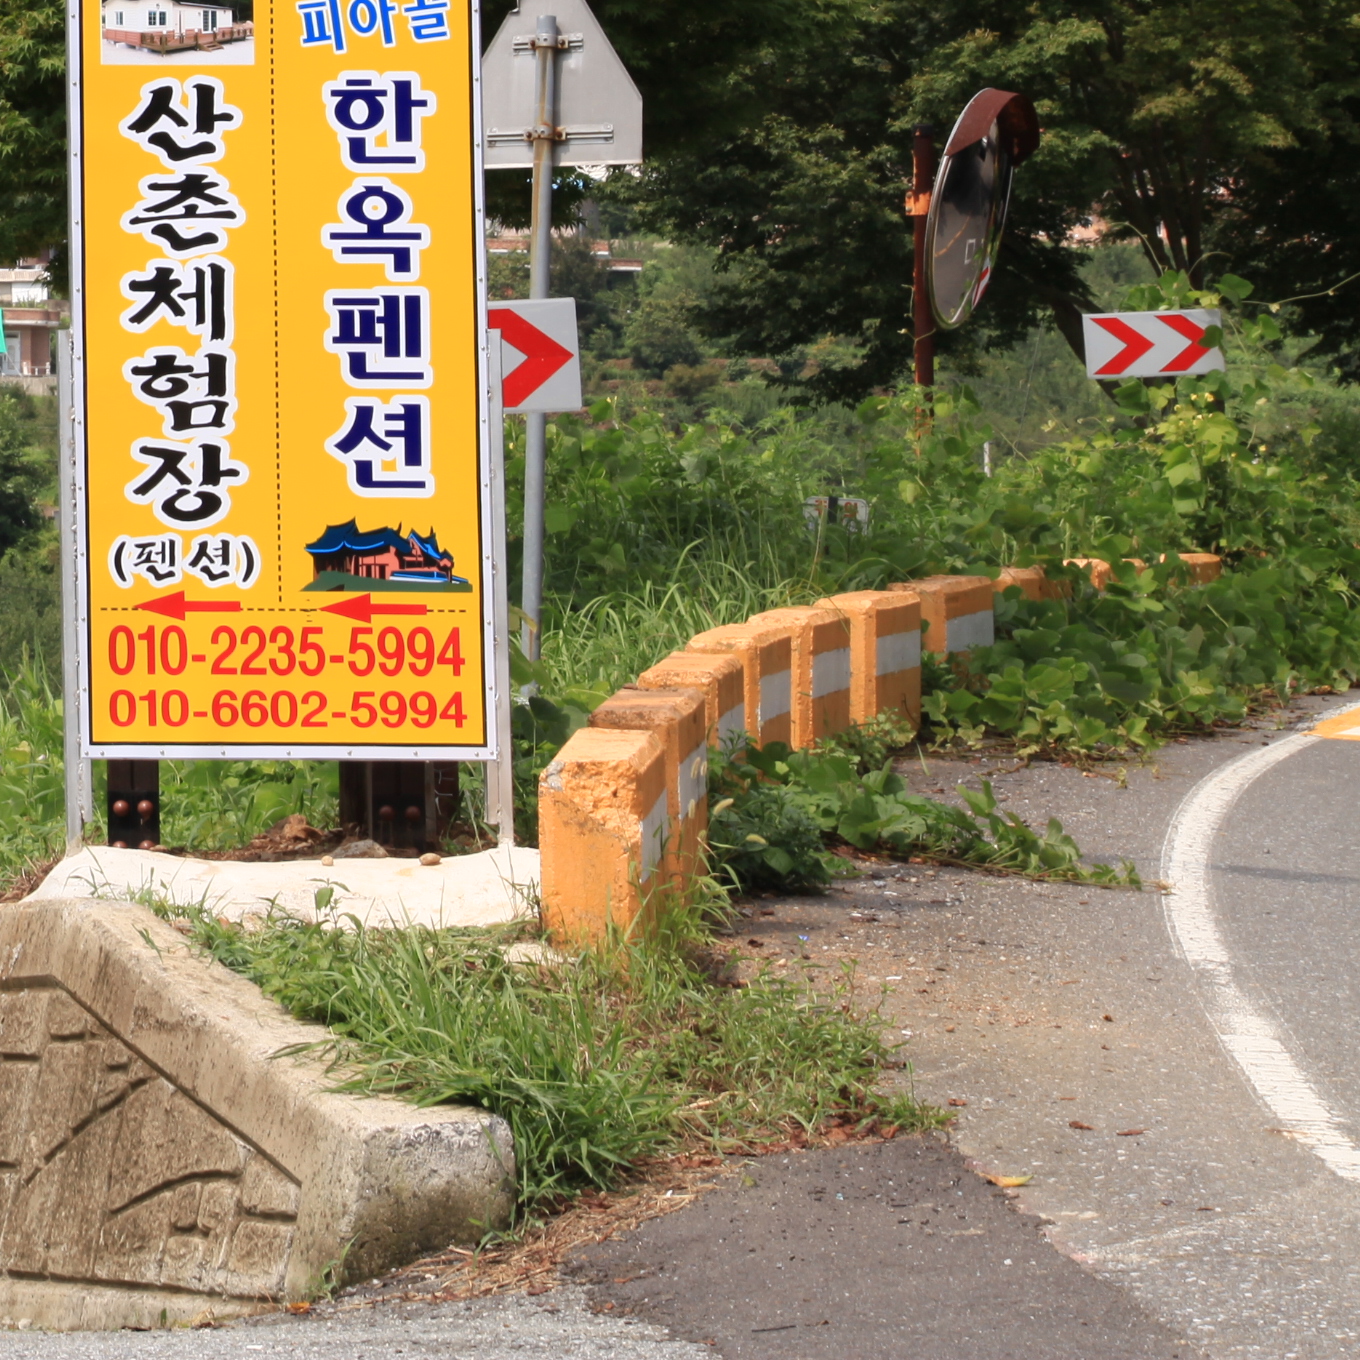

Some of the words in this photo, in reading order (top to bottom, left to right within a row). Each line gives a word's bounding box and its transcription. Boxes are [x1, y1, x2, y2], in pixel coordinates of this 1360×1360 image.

[126, 82, 241, 522] 산촌체험장
[113, 538, 255, 583] (펜션)
[108, 624, 466, 678] 010-2235-5994
[109, 689, 468, 729] 010-6602-5994
